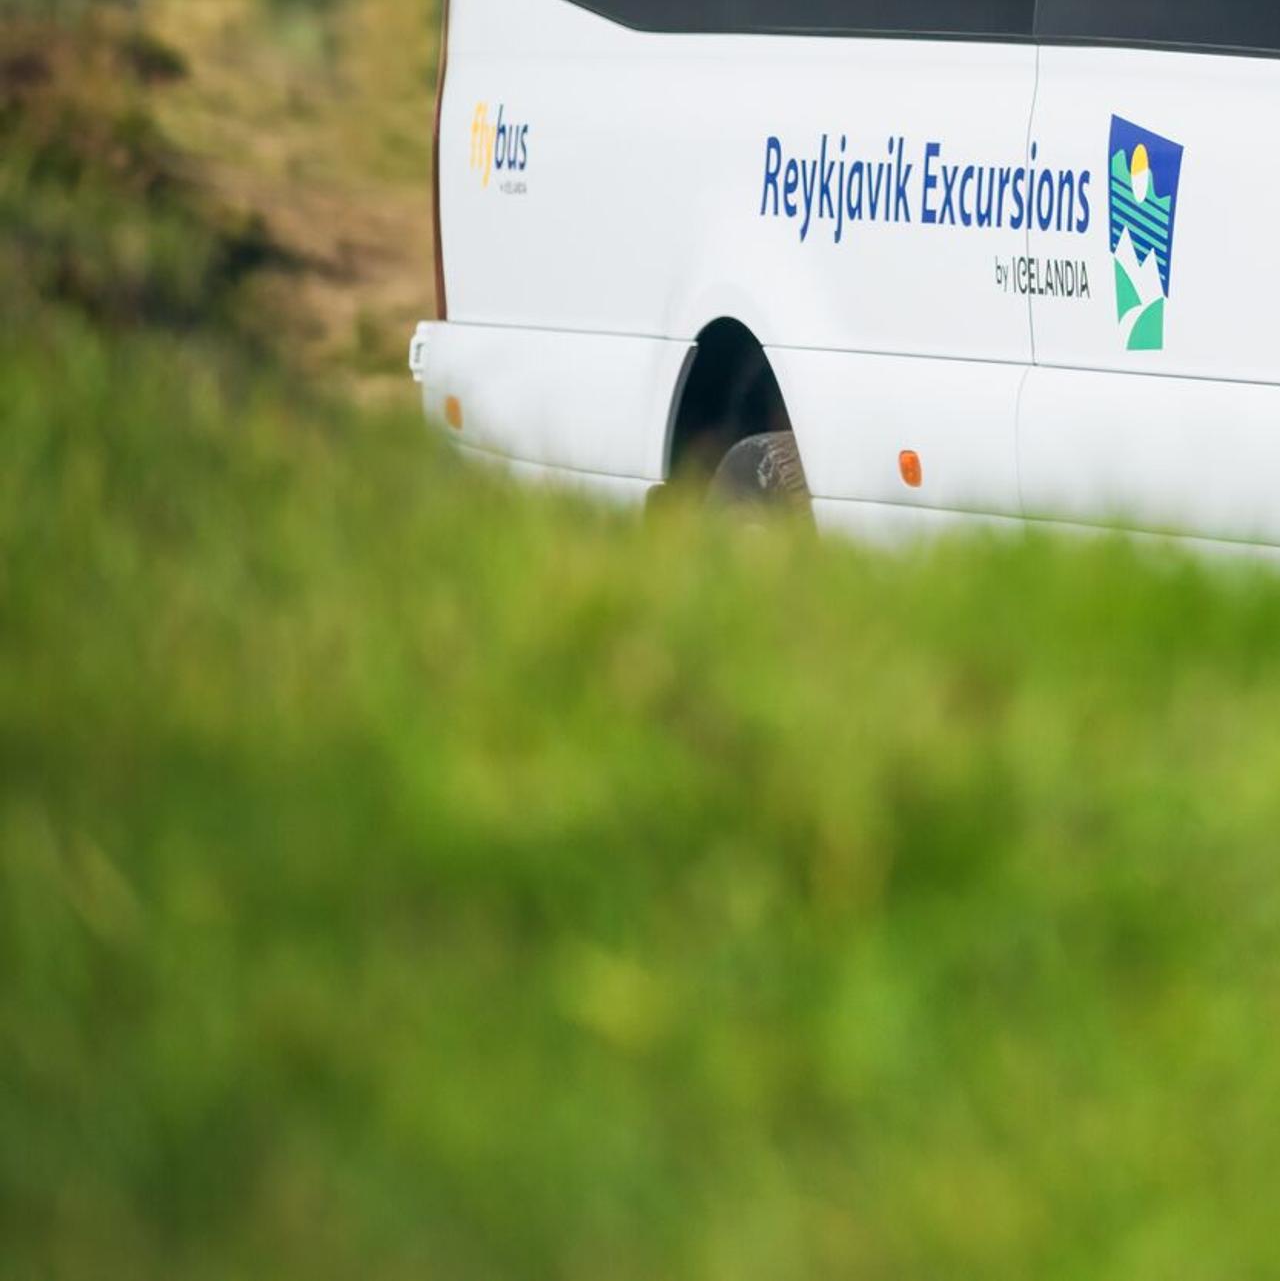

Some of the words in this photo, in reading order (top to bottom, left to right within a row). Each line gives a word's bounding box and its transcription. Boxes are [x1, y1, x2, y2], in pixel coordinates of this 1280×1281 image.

[760, 133, 913, 244] Reykjavik
[921, 140, 1091, 234] Excursions
[995, 255, 1009, 293] by
[1012, 256, 1091, 299] ICELANDIA
